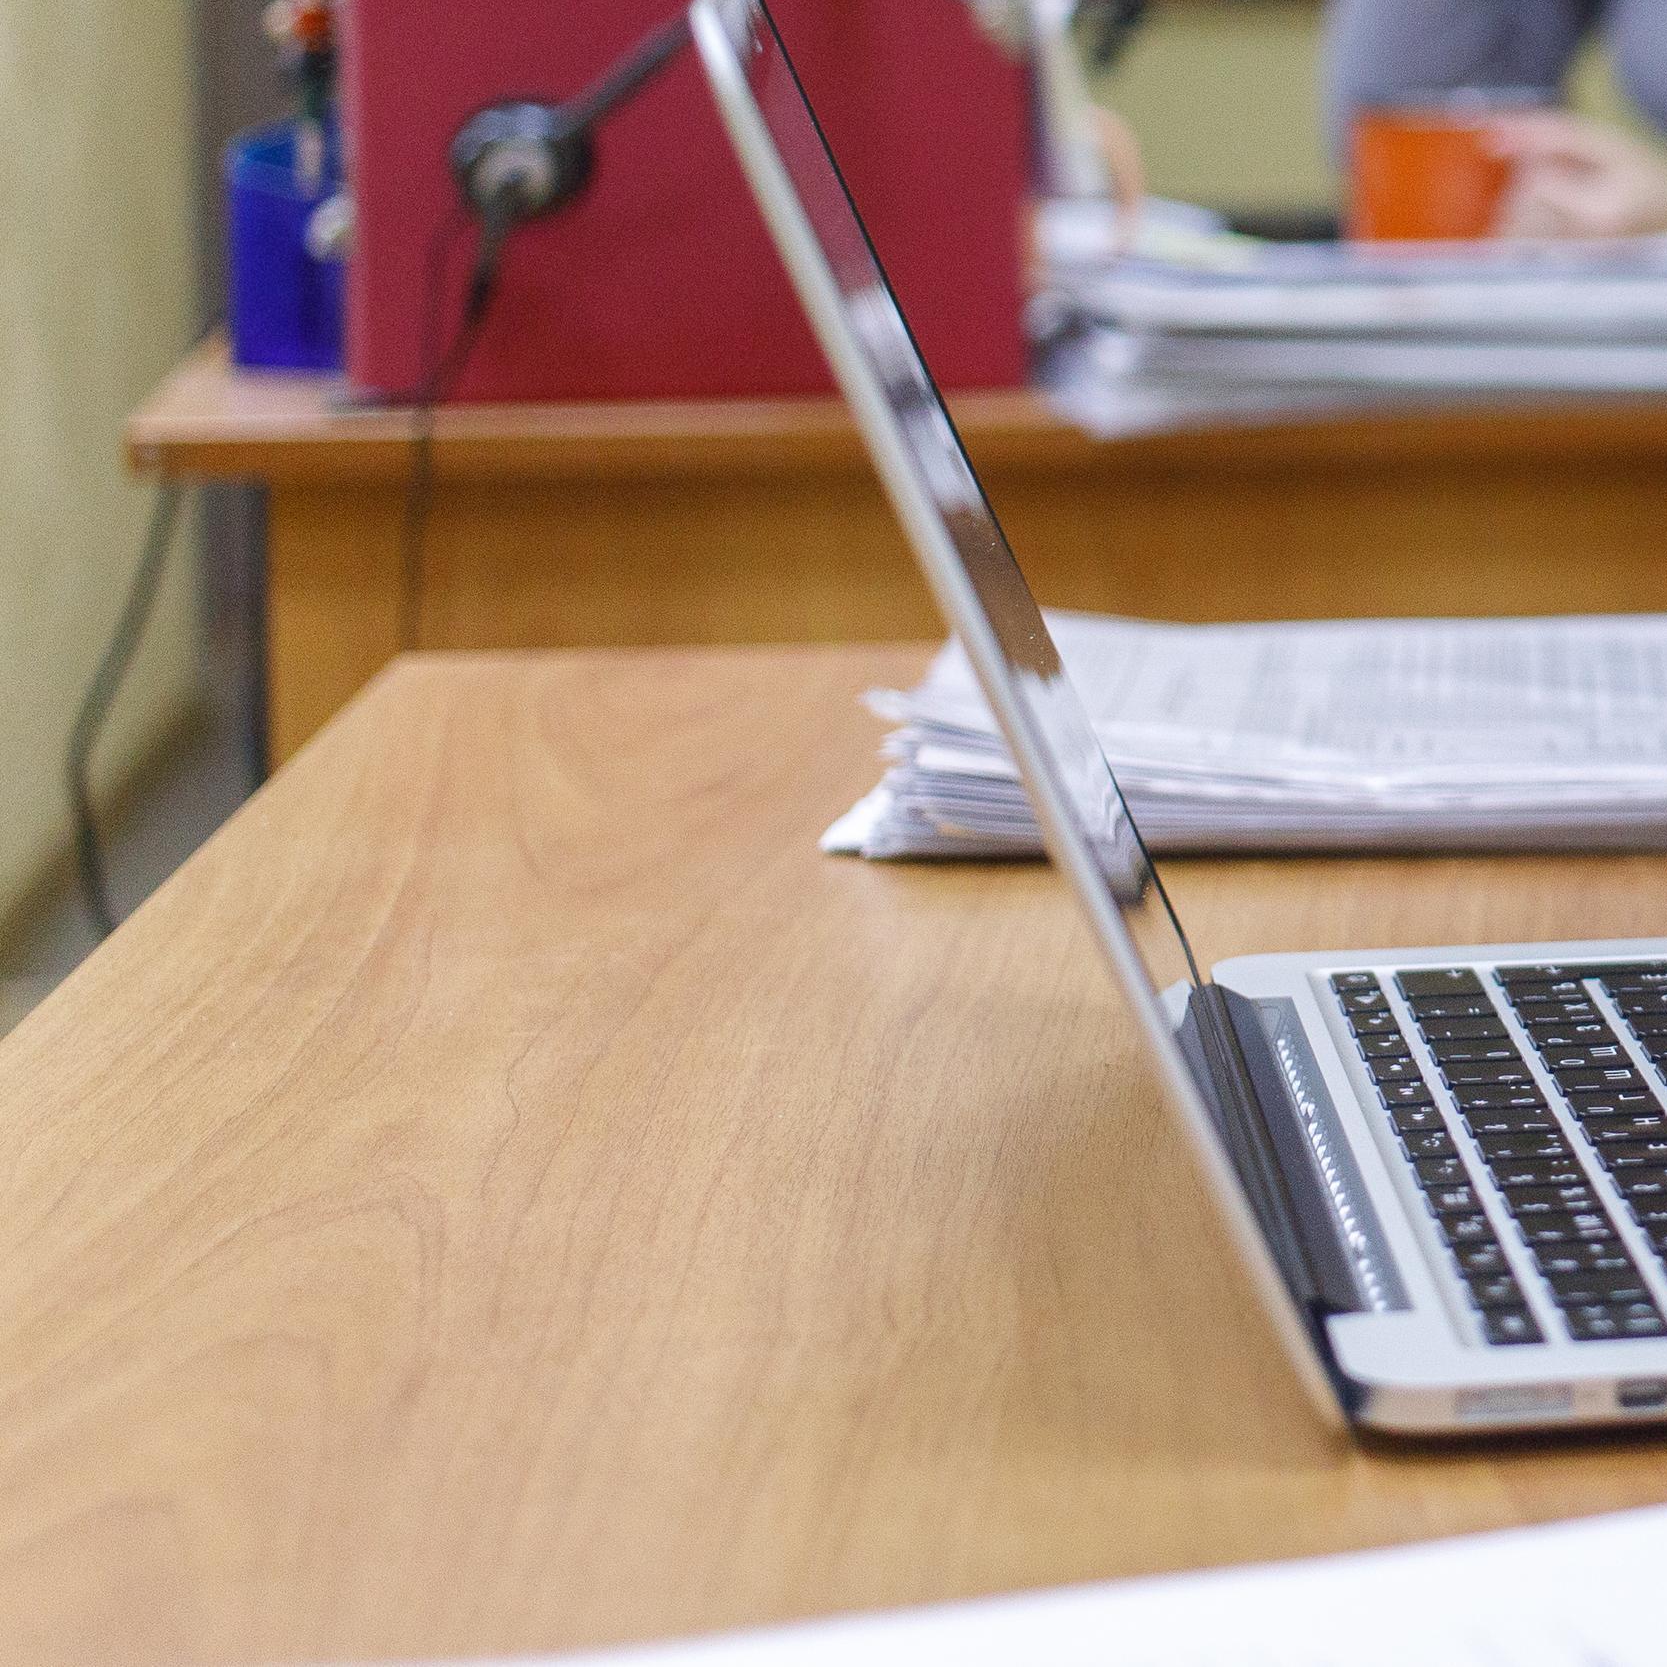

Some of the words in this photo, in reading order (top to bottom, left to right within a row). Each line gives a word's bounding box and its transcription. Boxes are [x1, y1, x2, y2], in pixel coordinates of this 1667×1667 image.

[1551, 982, 1577, 991] Ъ
[1563, 1002, 1589, 1011] Х
[1576, 1024, 1602, 1032] З
[1589, 1045, 1618, 1057] Щ
[1603, 1069, 1632, 1080] Ш
[1618, 1093, 1646, 1101] Г
[1587, 1106, 1615, 1114] U
[1633, 1117, 1661, 1126] Н
[1616, 1157, 1644, 1165] T
[1549, 1173, 1578, 1181] 5
[1632, 1183, 1661, 1192] R
